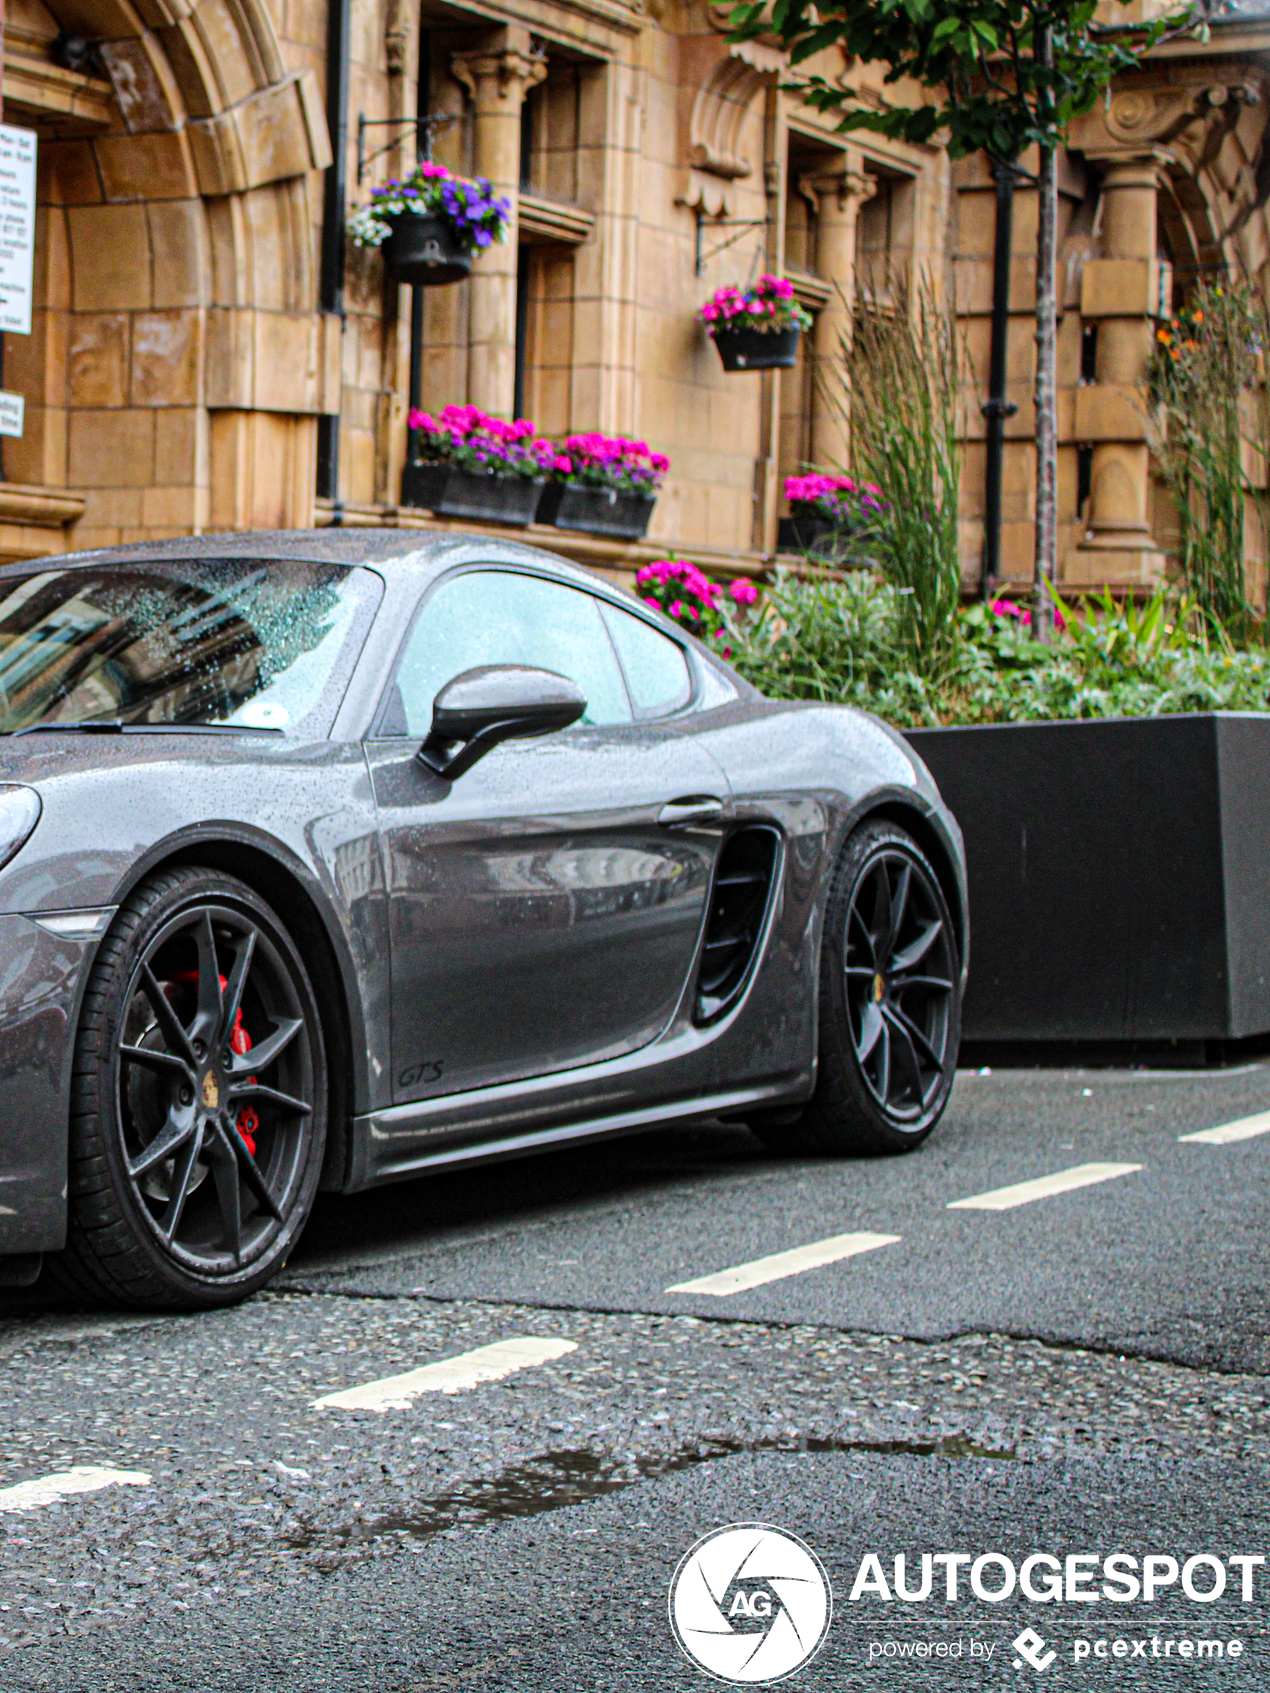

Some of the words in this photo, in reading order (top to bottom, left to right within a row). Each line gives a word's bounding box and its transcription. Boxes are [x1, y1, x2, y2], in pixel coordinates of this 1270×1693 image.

[0, 184, 20, 195] return
[8, 199, 28, 210] hours
[1, 415, 18, 427] time
[399, 1060, 445, 1087] GTS
